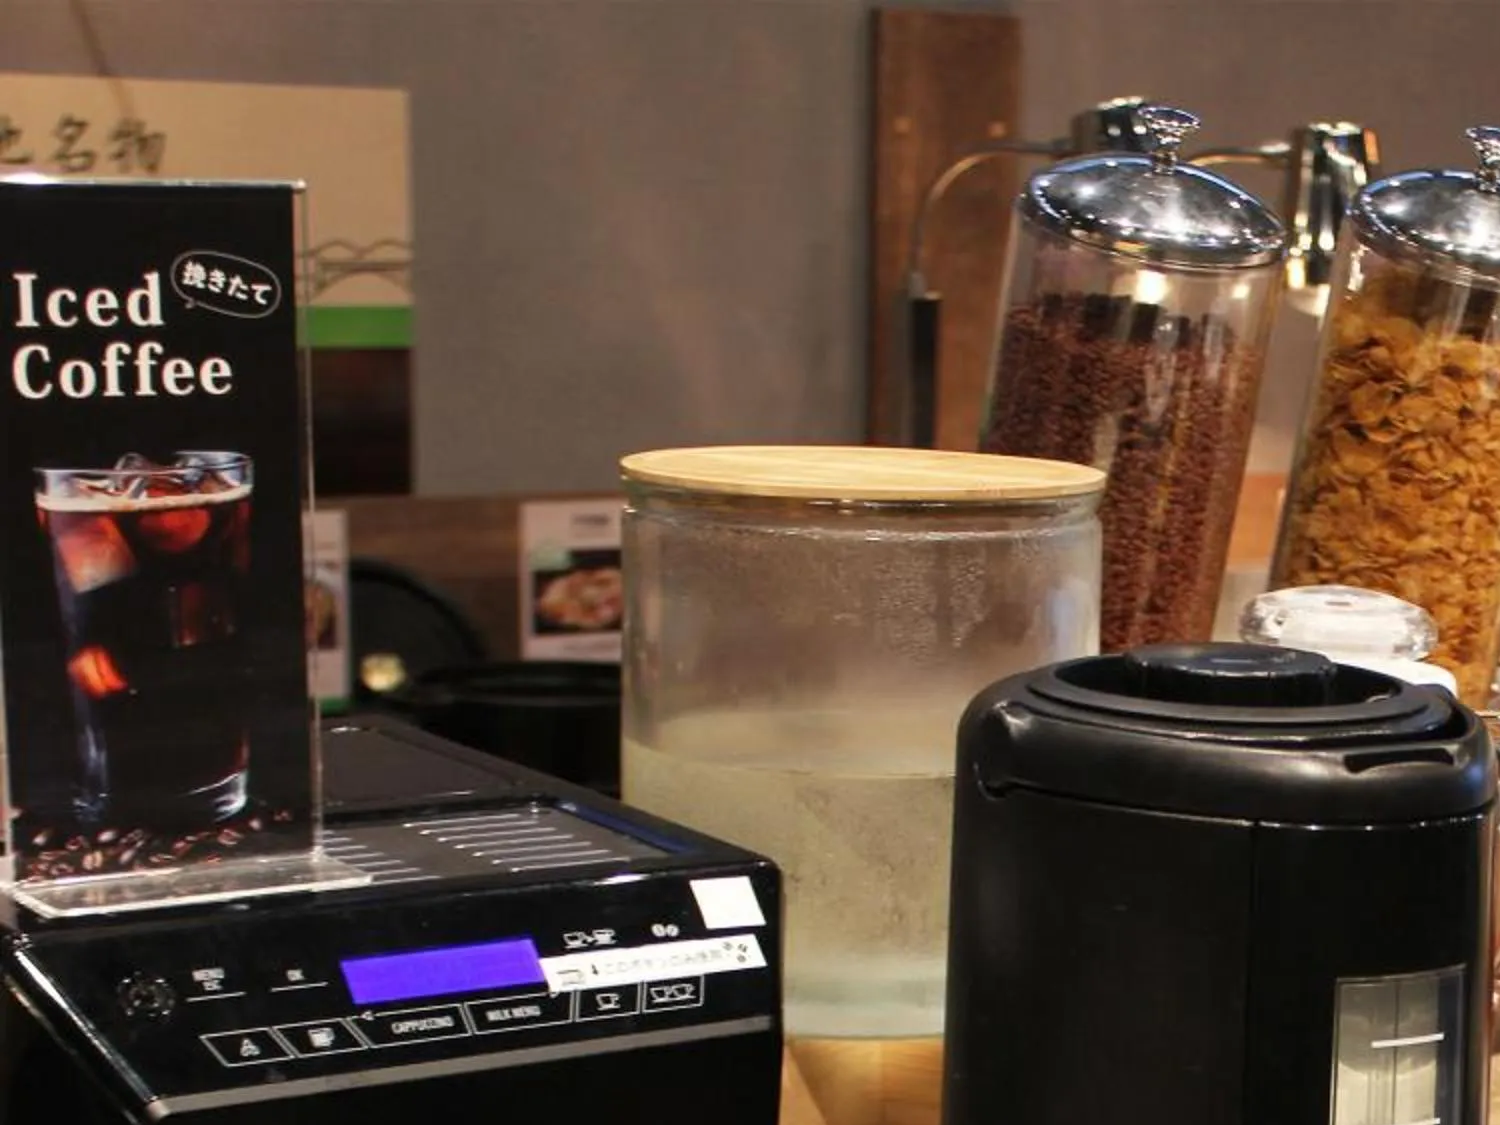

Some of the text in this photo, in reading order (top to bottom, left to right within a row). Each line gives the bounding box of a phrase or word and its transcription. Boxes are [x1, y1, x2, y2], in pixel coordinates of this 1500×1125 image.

[12, 271, 166, 328] Iced
[182, 260, 275, 306] 挽きたて
[12, 341, 234, 400] Coffee
